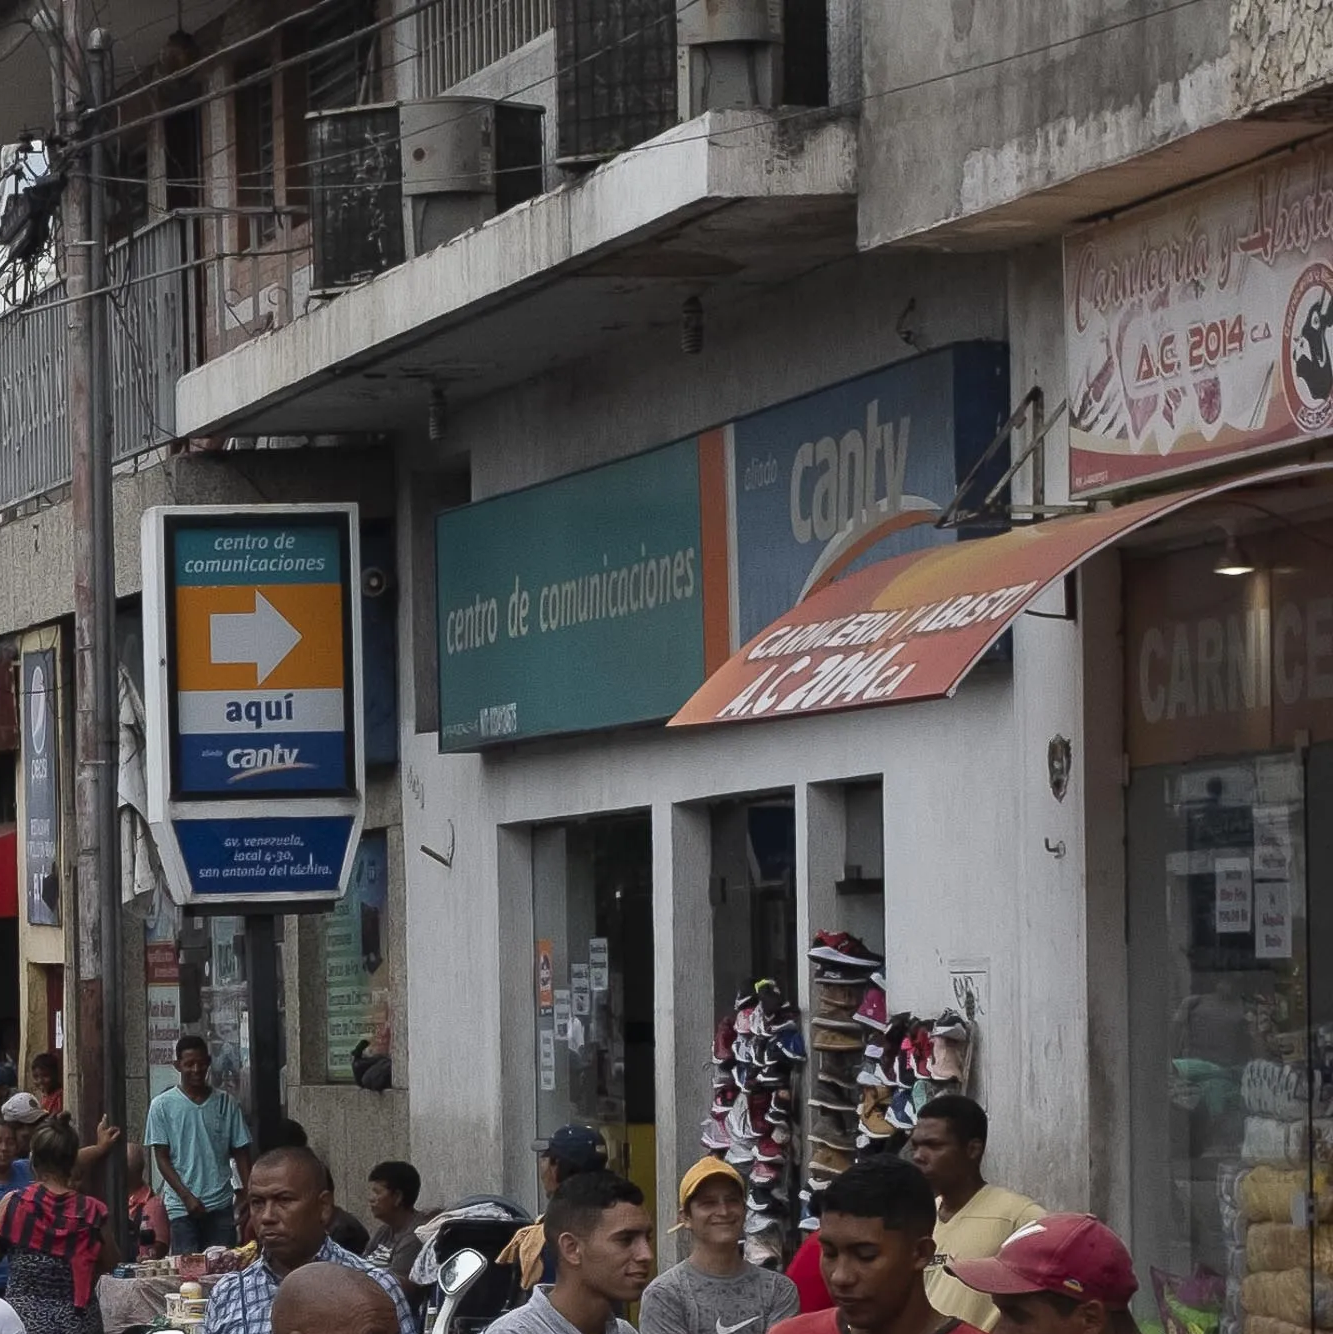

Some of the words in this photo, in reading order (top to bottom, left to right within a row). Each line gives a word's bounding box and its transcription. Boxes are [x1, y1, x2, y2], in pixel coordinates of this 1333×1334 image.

[1187, 313, 1245, 368] 2014
[790, 399, 911, 544] cantv
[214, 534, 270, 551] centro
[274, 532, 296, 549] de
[184, 554, 326, 574] comunicaciones
[445, 593, 498, 655] centro
[507, 574, 530, 639] de
[538, 543, 695, 632] comunicaciones
[775, 641, 906, 711] 2014
[226, 693, 295, 729] aquí
[226, 743, 300, 769] cantv
[198, 868, 220, 878] san
[222, 865, 266, 877] antonio
[268, 864, 288, 876] del
[233, 850, 262, 861] local
